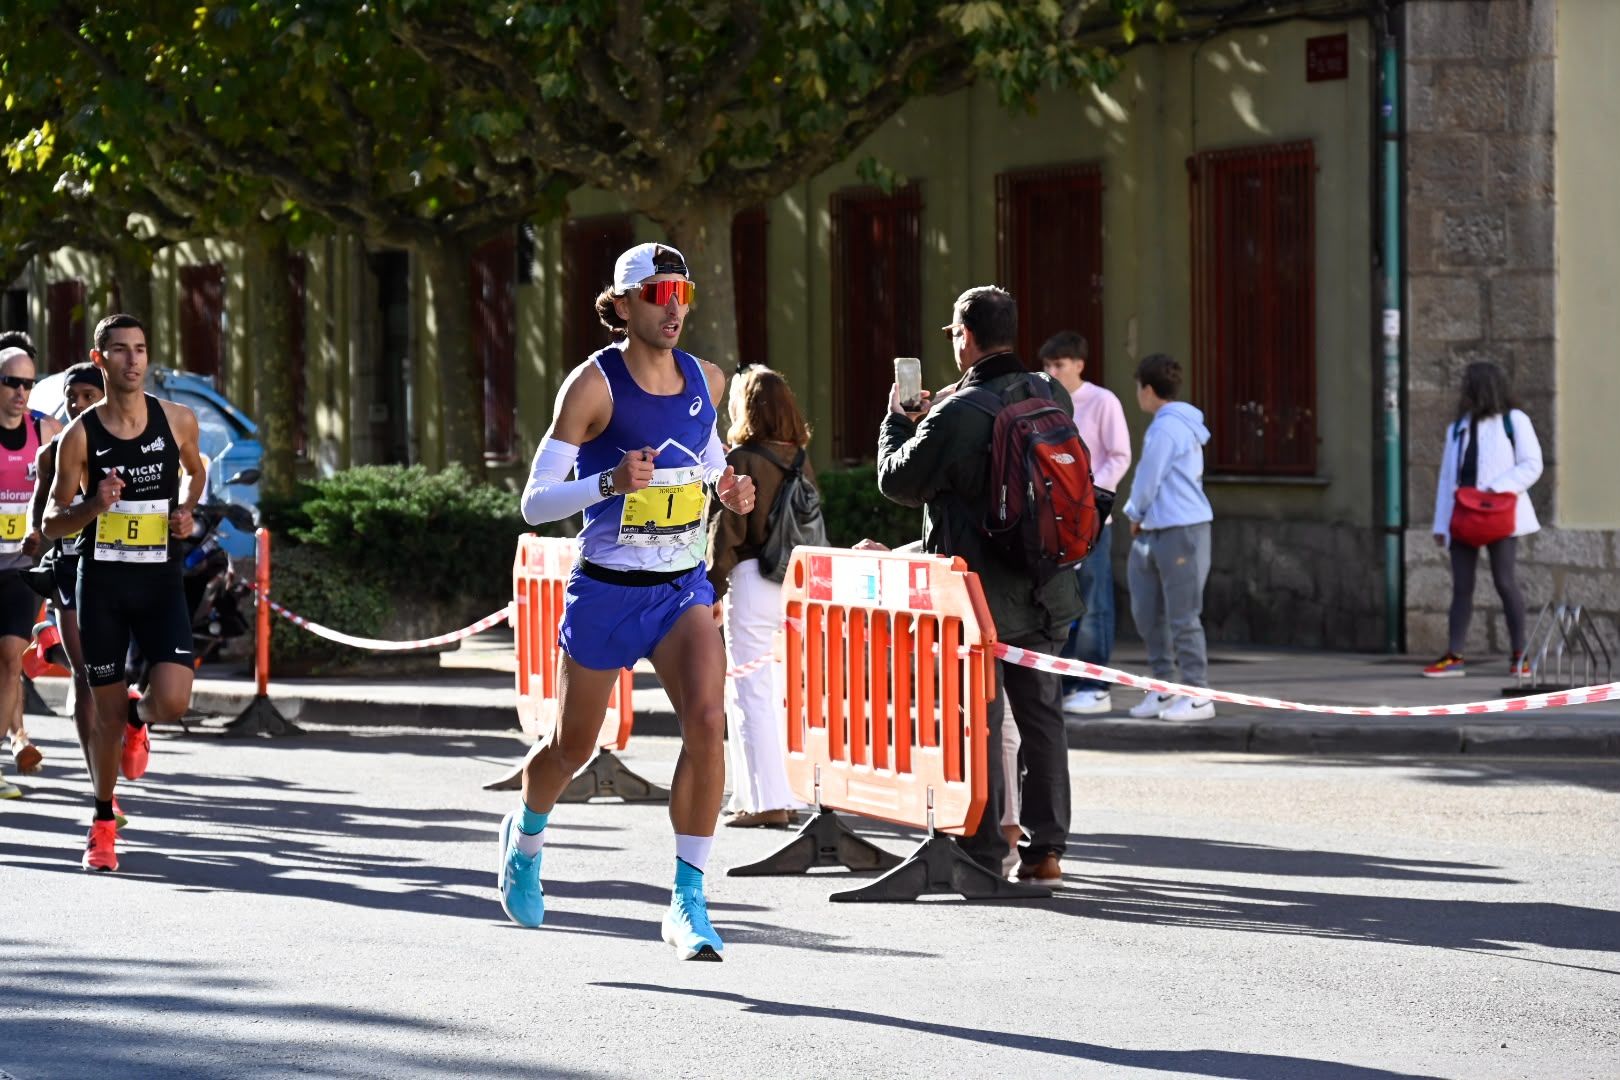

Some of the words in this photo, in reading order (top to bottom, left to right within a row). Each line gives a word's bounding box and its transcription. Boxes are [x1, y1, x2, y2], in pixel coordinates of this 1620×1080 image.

[128, 462, 164, 476] VICKY
[132, 473, 161, 483] FOODS
[666, 494, 674, 519] 1
[7, 519, 16, 535] 5
[127, 520, 139, 539] 6
